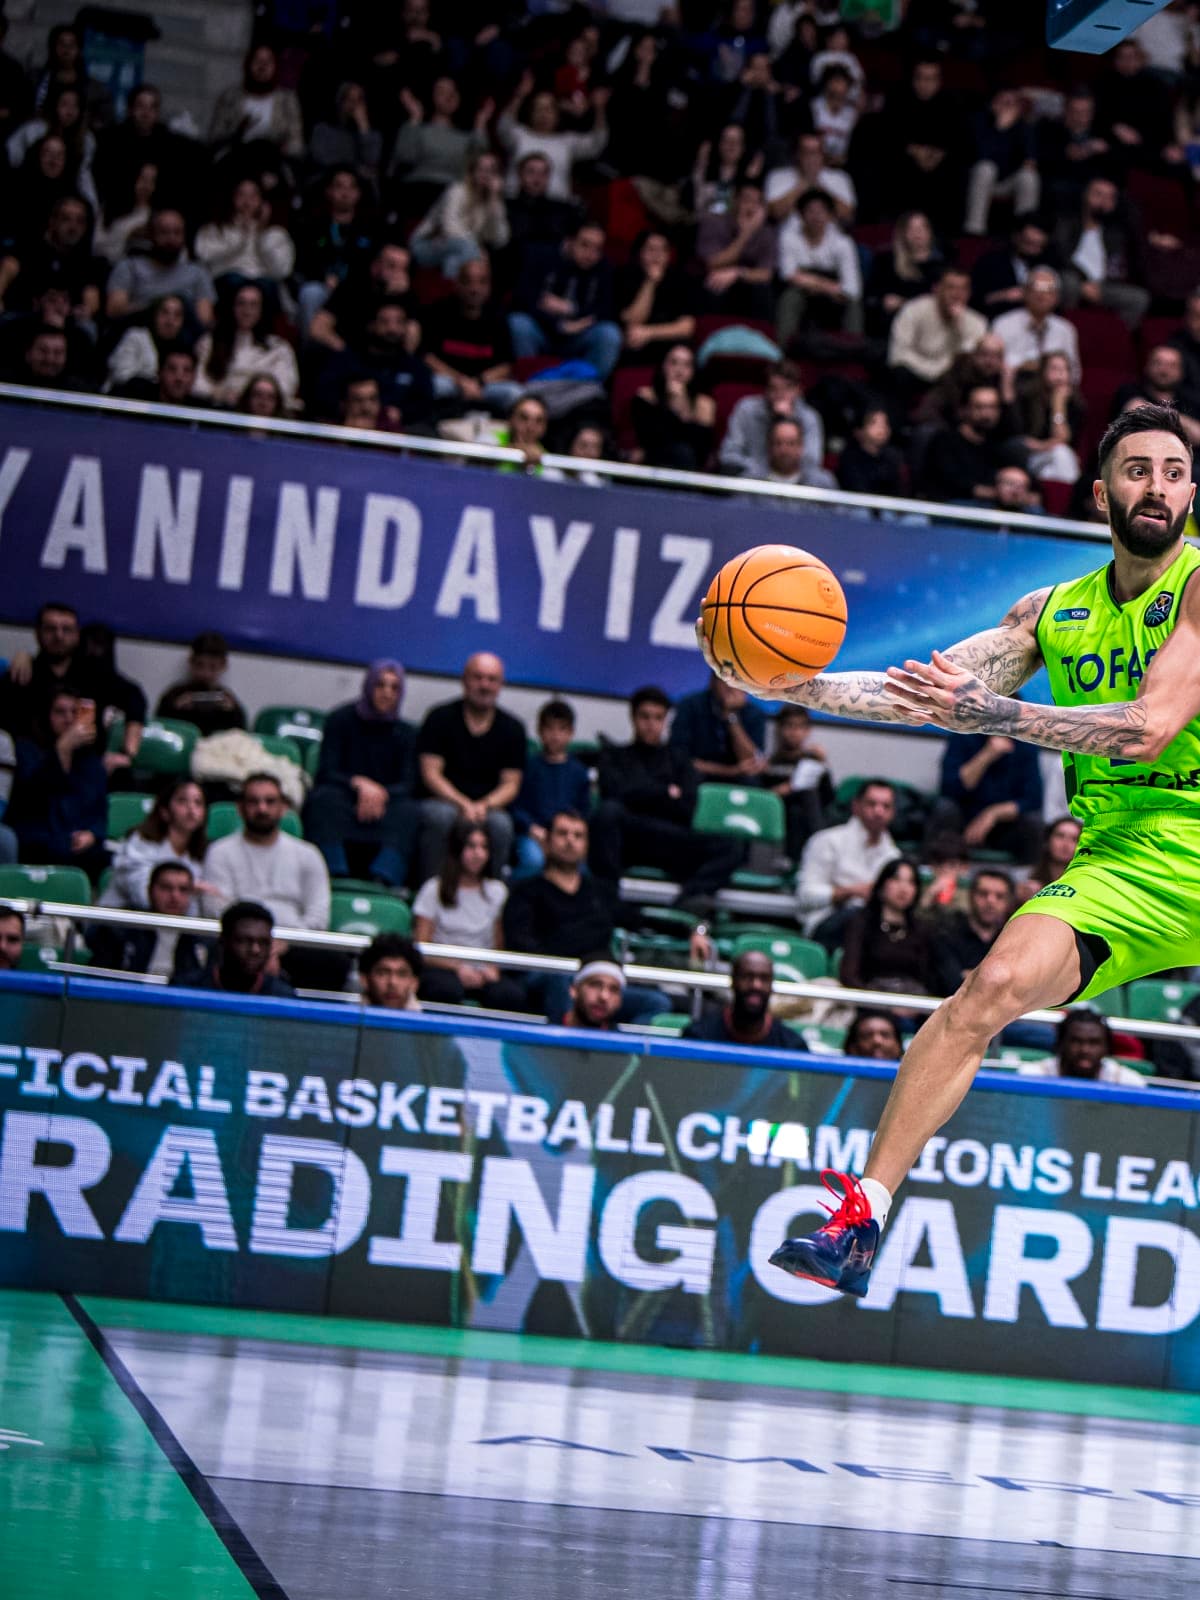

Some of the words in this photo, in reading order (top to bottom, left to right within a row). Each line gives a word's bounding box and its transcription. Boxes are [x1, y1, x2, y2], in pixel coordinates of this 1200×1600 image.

[0, 1109, 718, 1296] RADING
[245, 1070, 665, 1157] BASKETBALL
[675, 1111, 1074, 1195] CHAMIONS
